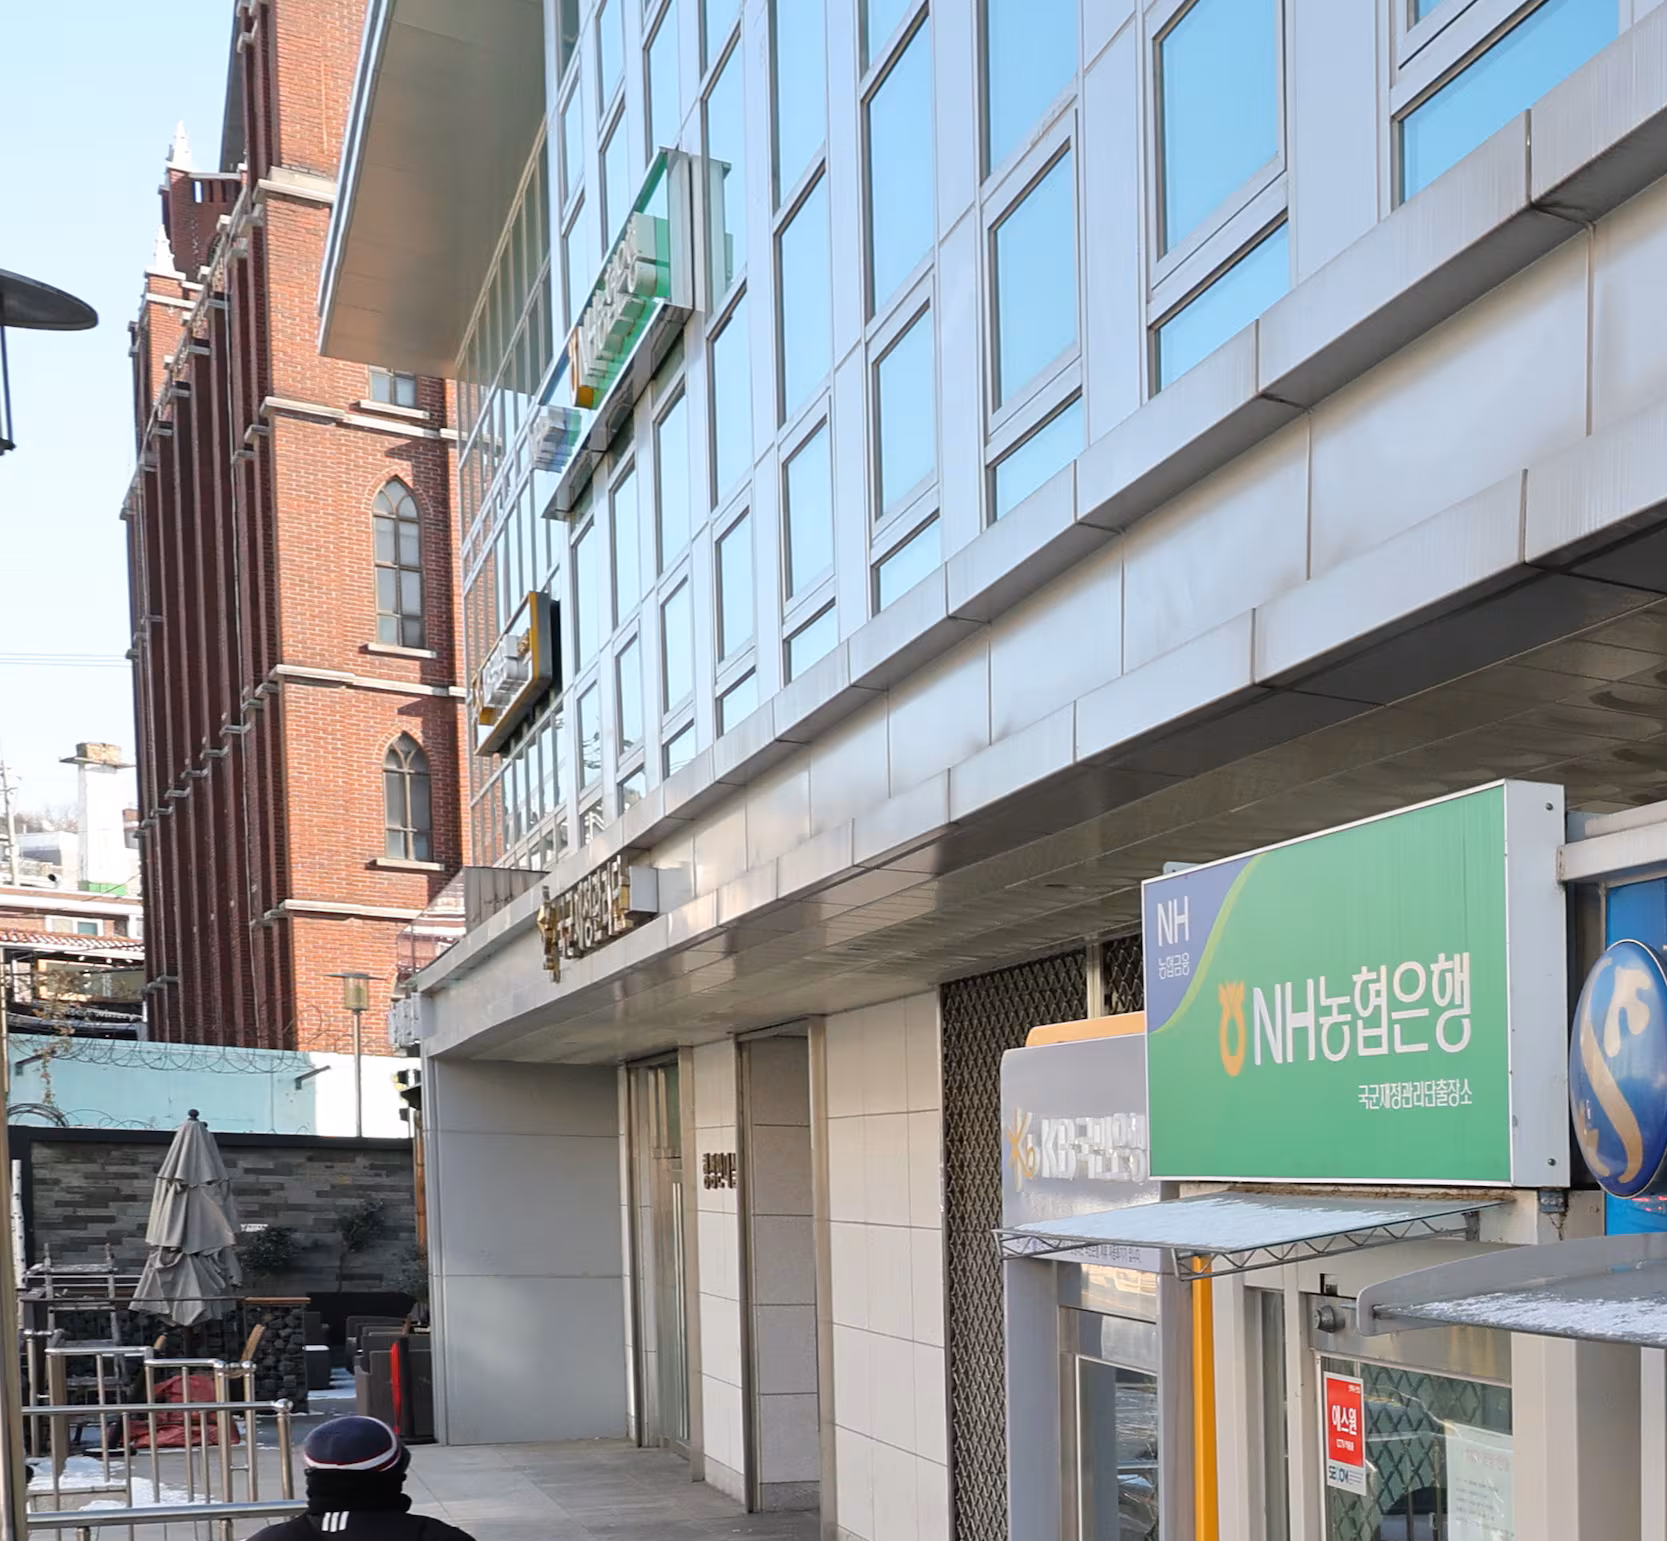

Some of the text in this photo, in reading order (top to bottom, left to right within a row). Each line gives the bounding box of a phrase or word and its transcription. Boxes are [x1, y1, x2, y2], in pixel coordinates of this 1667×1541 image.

[1157, 896, 1189, 946] NH
[1253, 952, 1472, 1066] NH농협은행
[1358, 1078, 1473, 1110] 국군재정관리단출장소
[1332, 1404, 1358, 1436] 에스원
